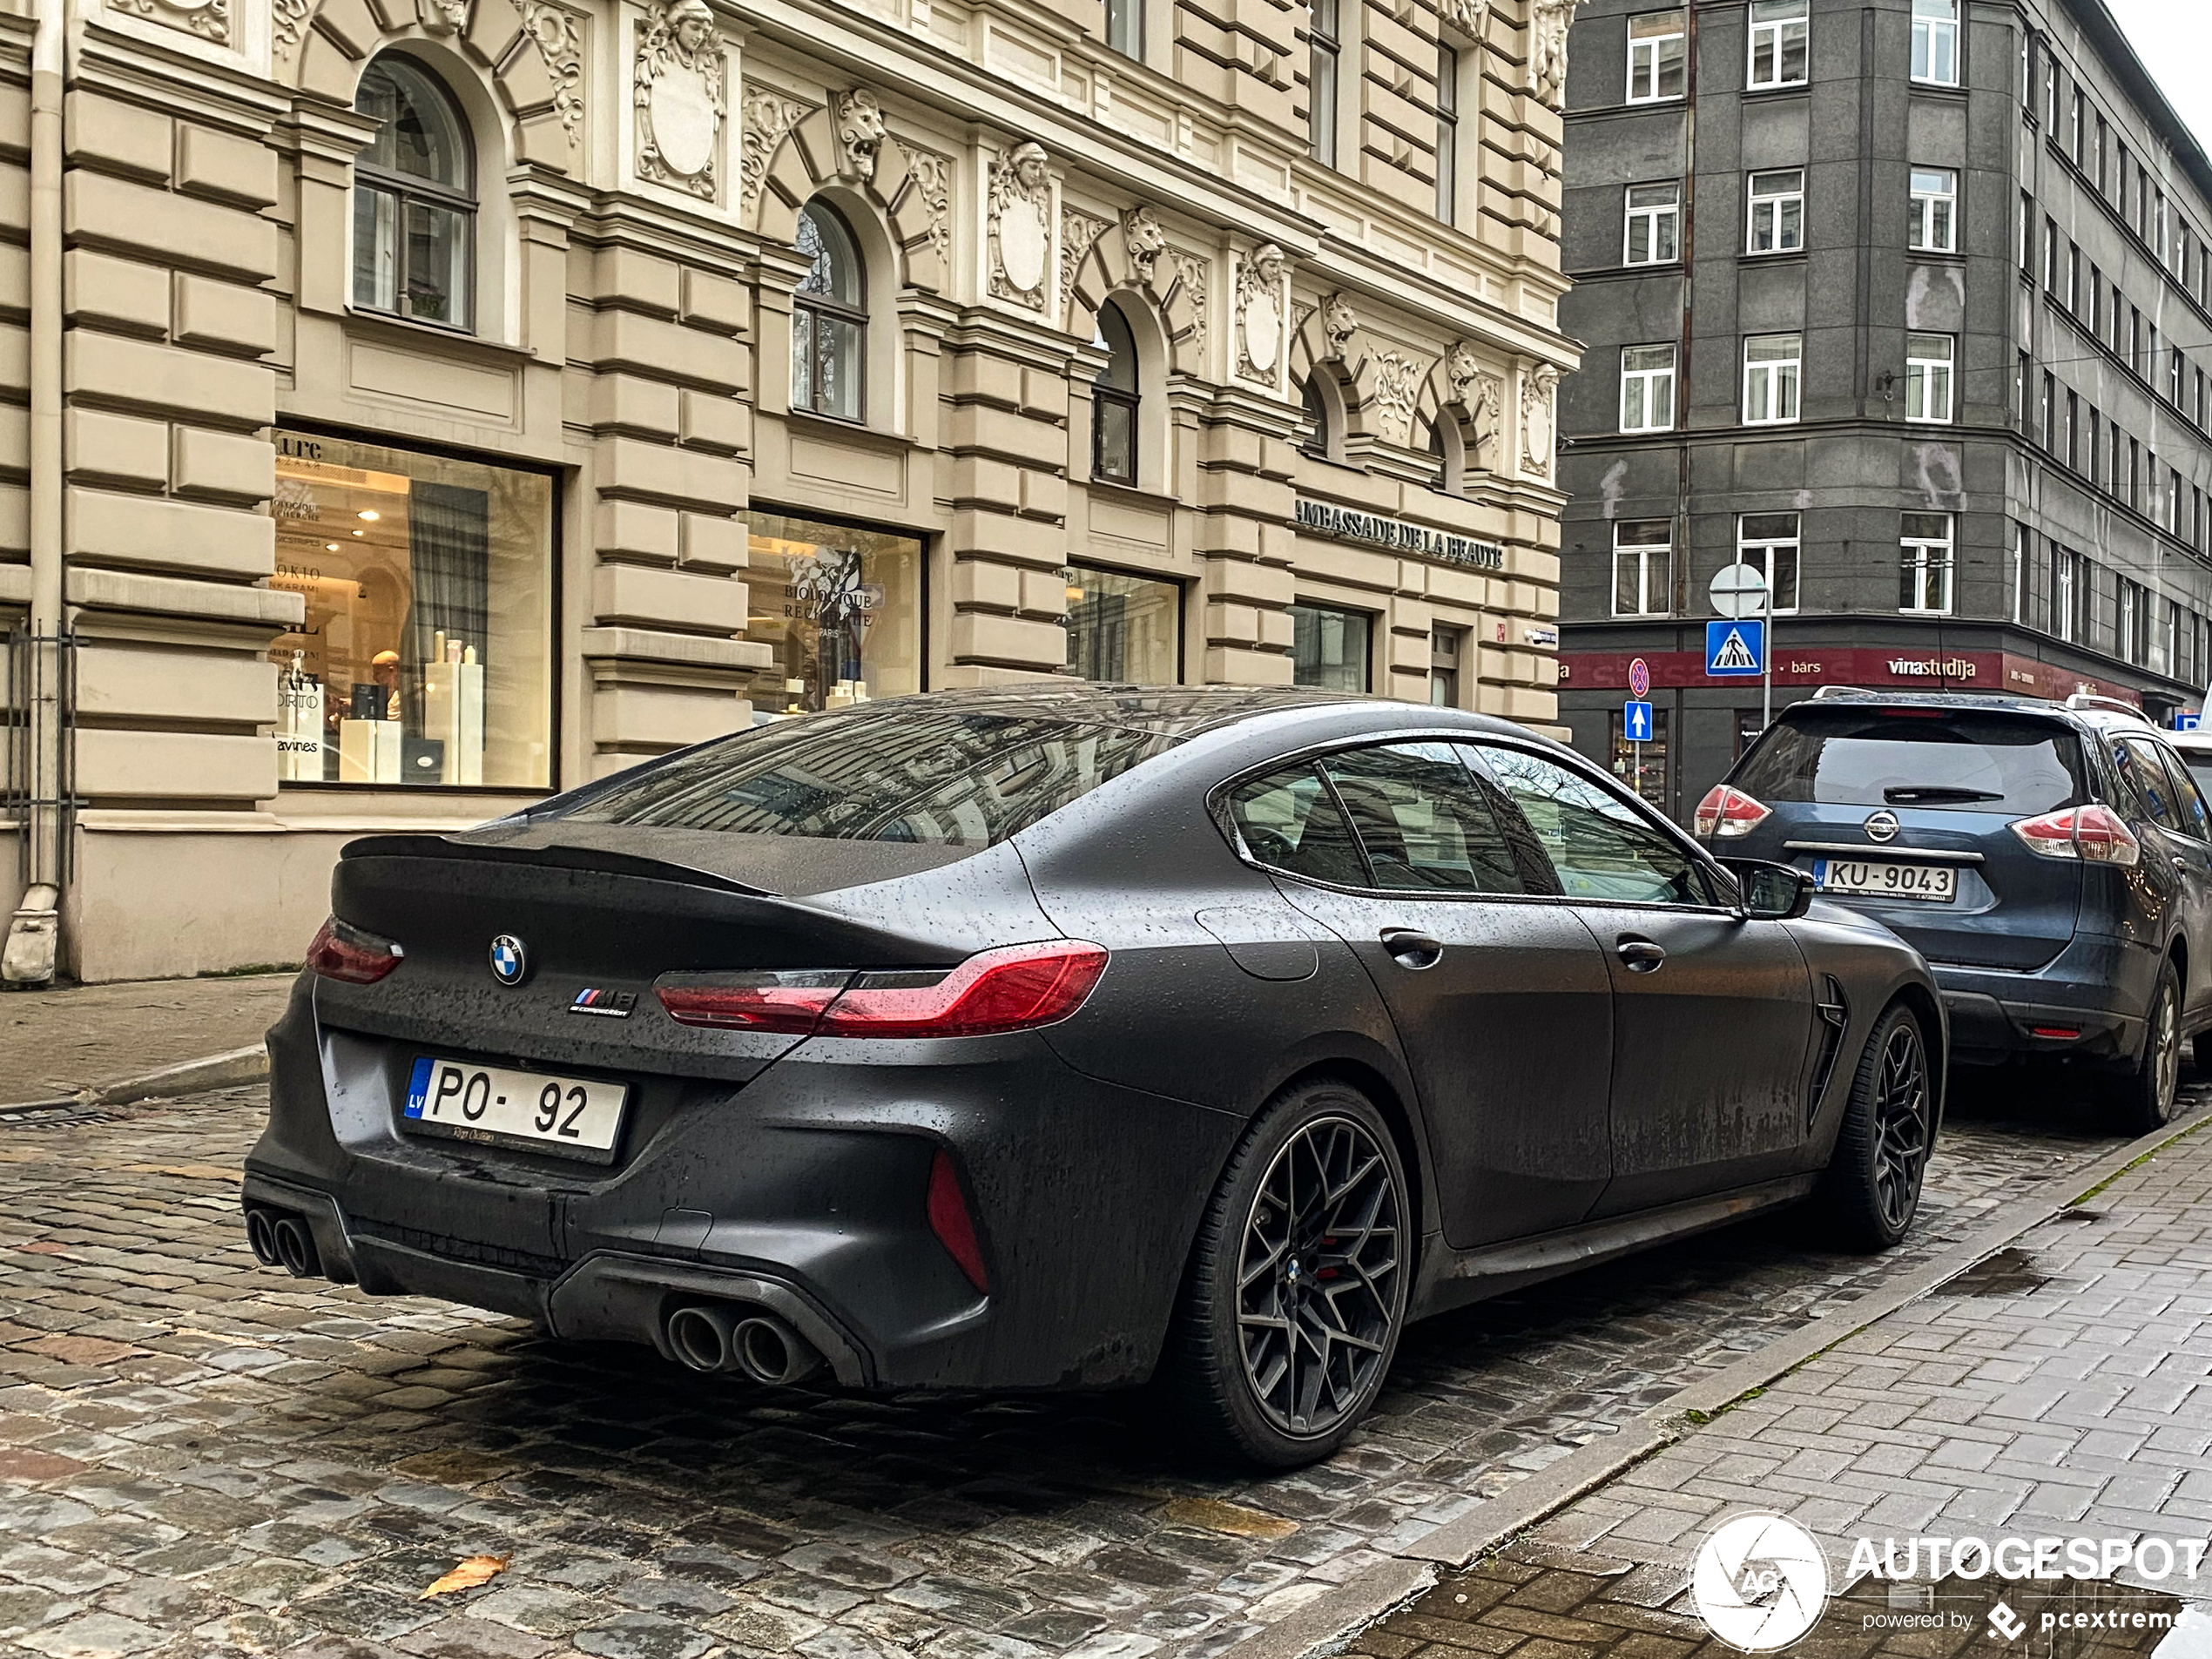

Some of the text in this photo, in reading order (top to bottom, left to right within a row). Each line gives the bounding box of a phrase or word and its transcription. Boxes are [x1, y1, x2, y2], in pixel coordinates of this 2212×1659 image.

[1398, 523, 1422, 550] DE
[1424, 531, 1446, 556] LA
[784, 585, 872, 609] BIOLOGIQUE
[819, 628, 840, 638] PARIS
[272, 731, 318, 752] avines
[1831, 862, 1949, 892] KU-9043
[408, 1094, 424, 1109] LV
